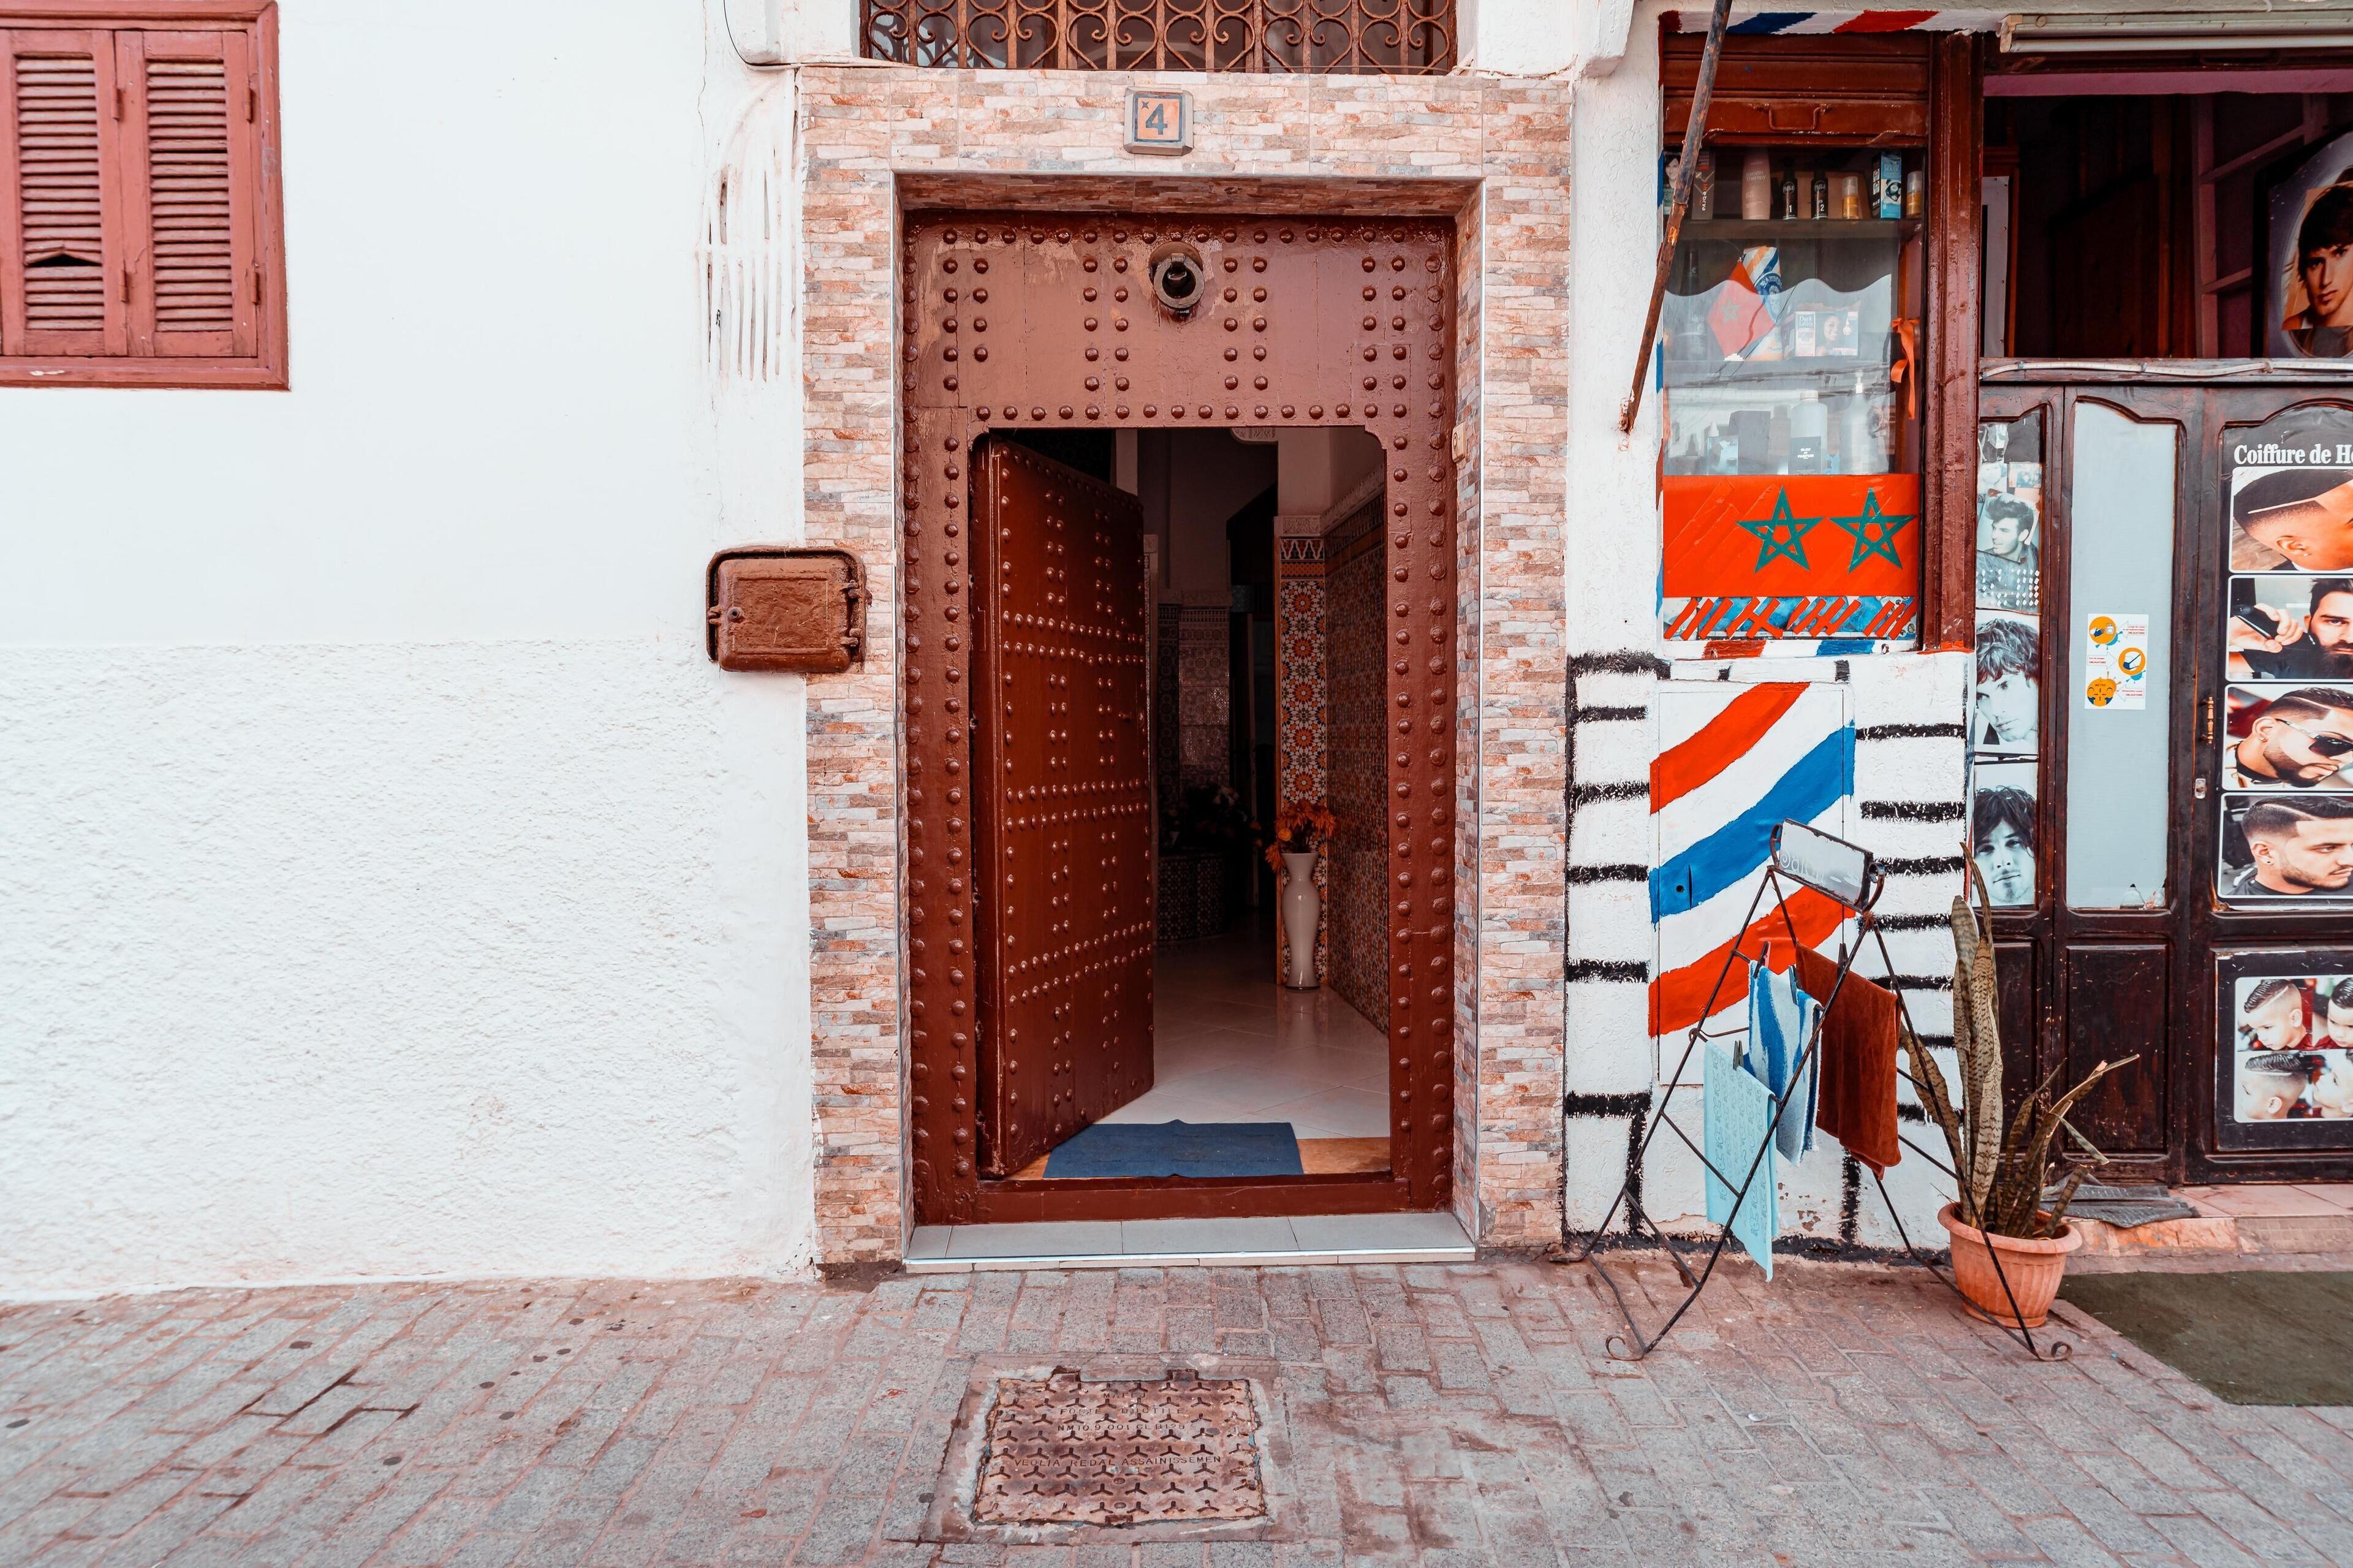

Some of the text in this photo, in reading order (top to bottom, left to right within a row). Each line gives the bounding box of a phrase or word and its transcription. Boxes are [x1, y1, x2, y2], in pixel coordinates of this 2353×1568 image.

[1146, 103, 1167, 135] 4
[2234, 444, 2353, 464] Coiffure de H
